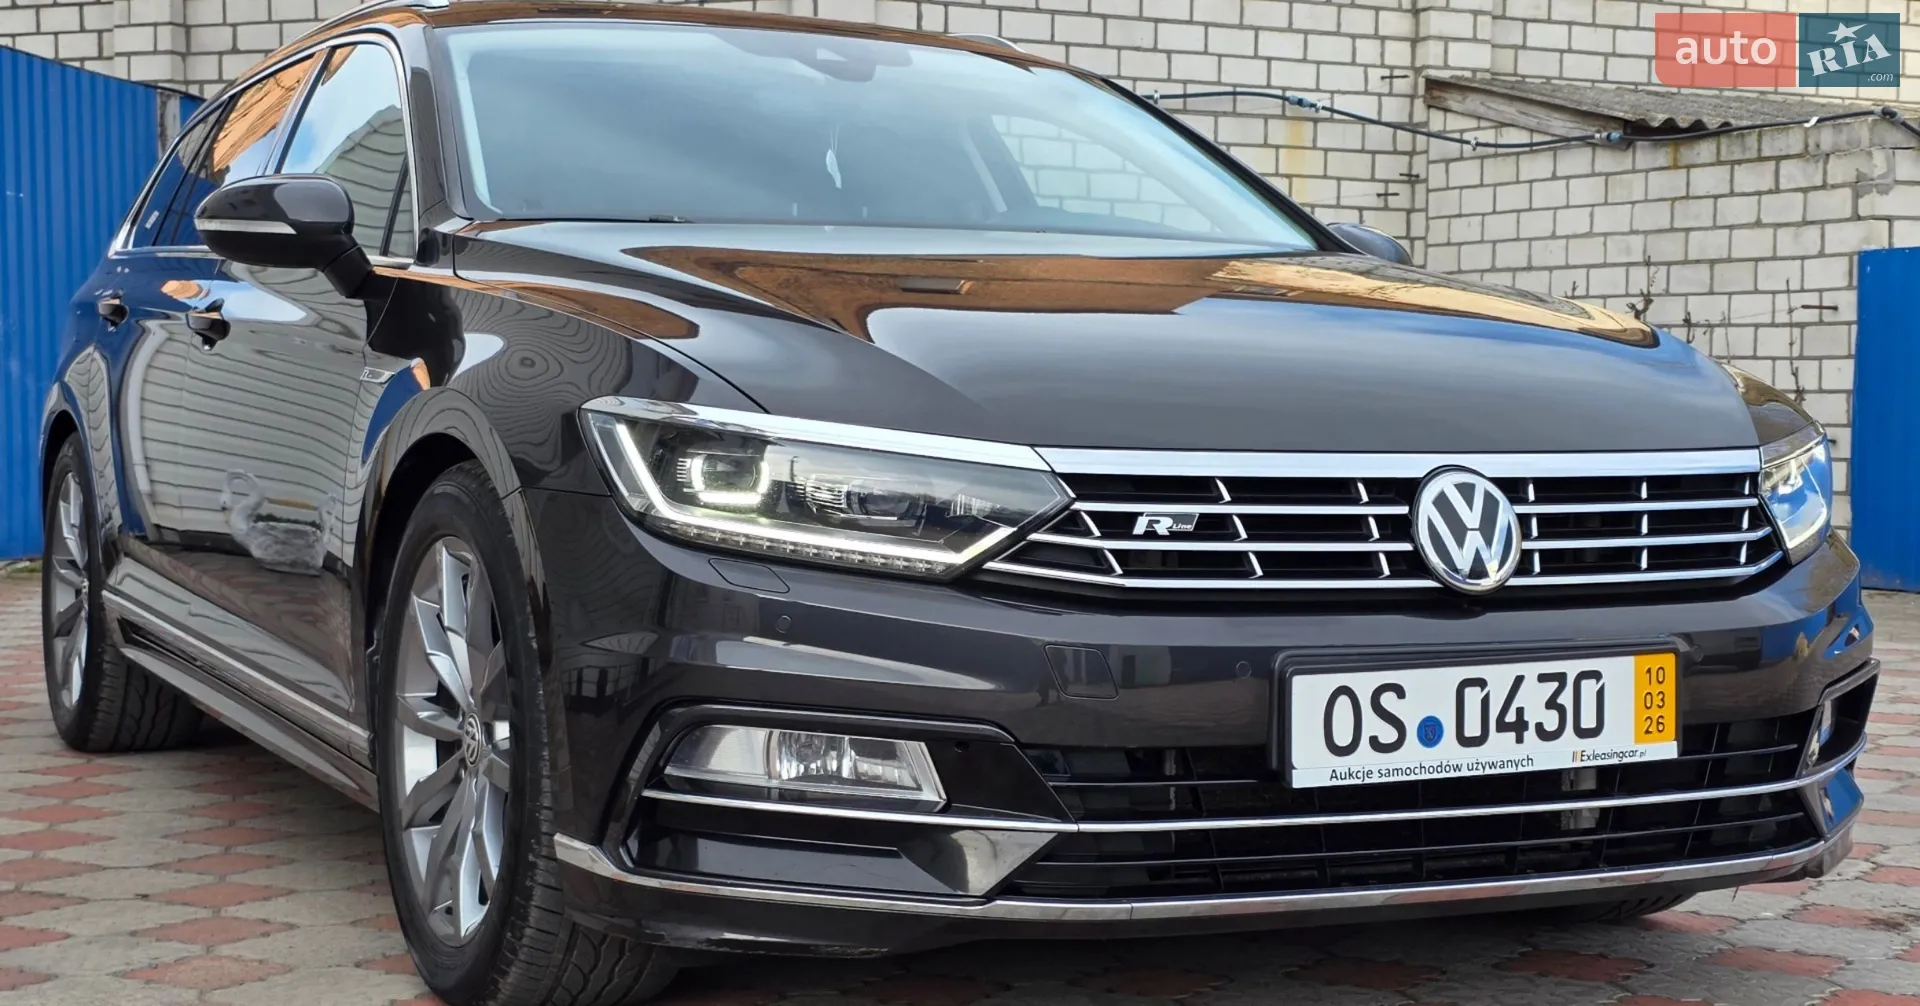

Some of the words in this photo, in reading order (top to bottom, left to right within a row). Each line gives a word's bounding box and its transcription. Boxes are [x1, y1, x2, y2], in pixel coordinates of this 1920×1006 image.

[1645, 666, 1666, 685] 10
[1643, 691, 1666, 710] 03
[1323, 683, 1407, 757] OS
[1455, 670, 1605, 748] 0430
[1643, 715, 1666, 735] 26
[1329, 767, 1373, 782] Aukcje
[1377, 761, 1463, 778] samochodów
[1466, 755, 1534, 773] używanych
